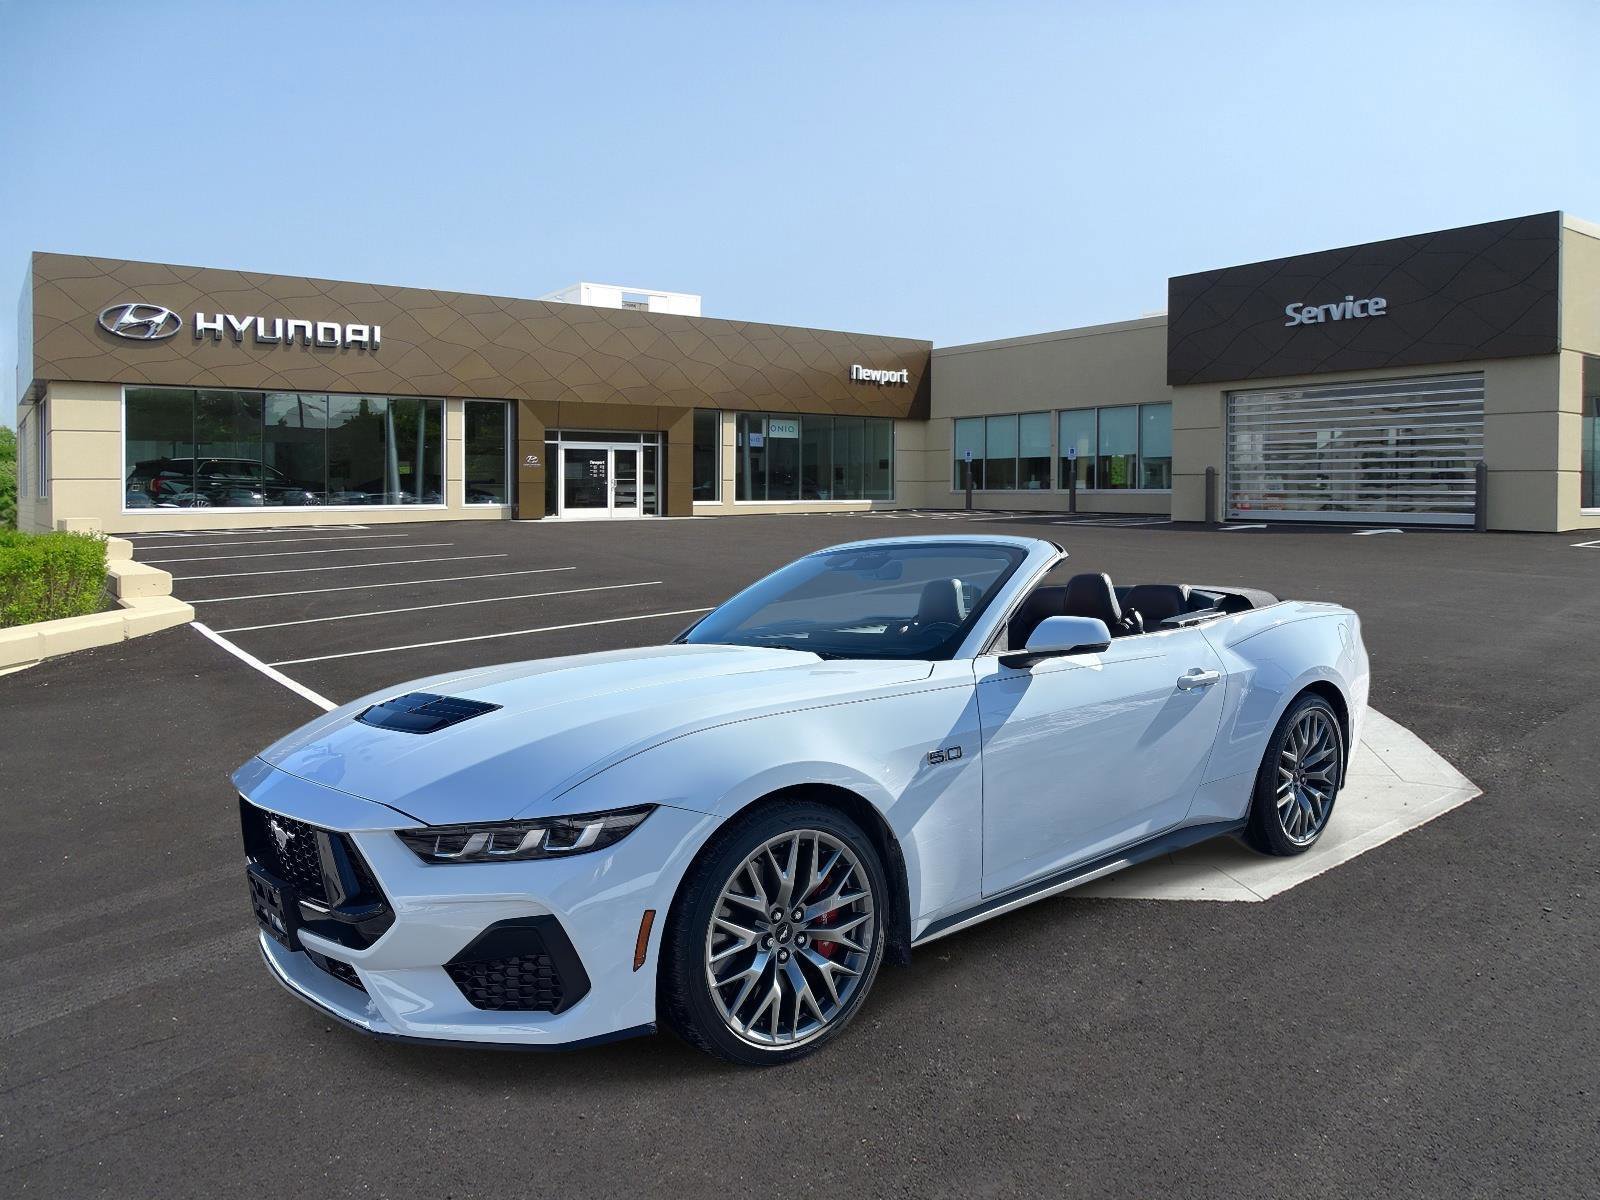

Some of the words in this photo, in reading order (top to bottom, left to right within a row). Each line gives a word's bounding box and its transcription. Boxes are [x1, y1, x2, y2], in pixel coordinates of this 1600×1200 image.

[1285, 295, 1387, 326] Service
[195, 312, 381, 349] HYUNDAI
[851, 364, 908, 385] Newport
[928, 746, 963, 765] 5.0
